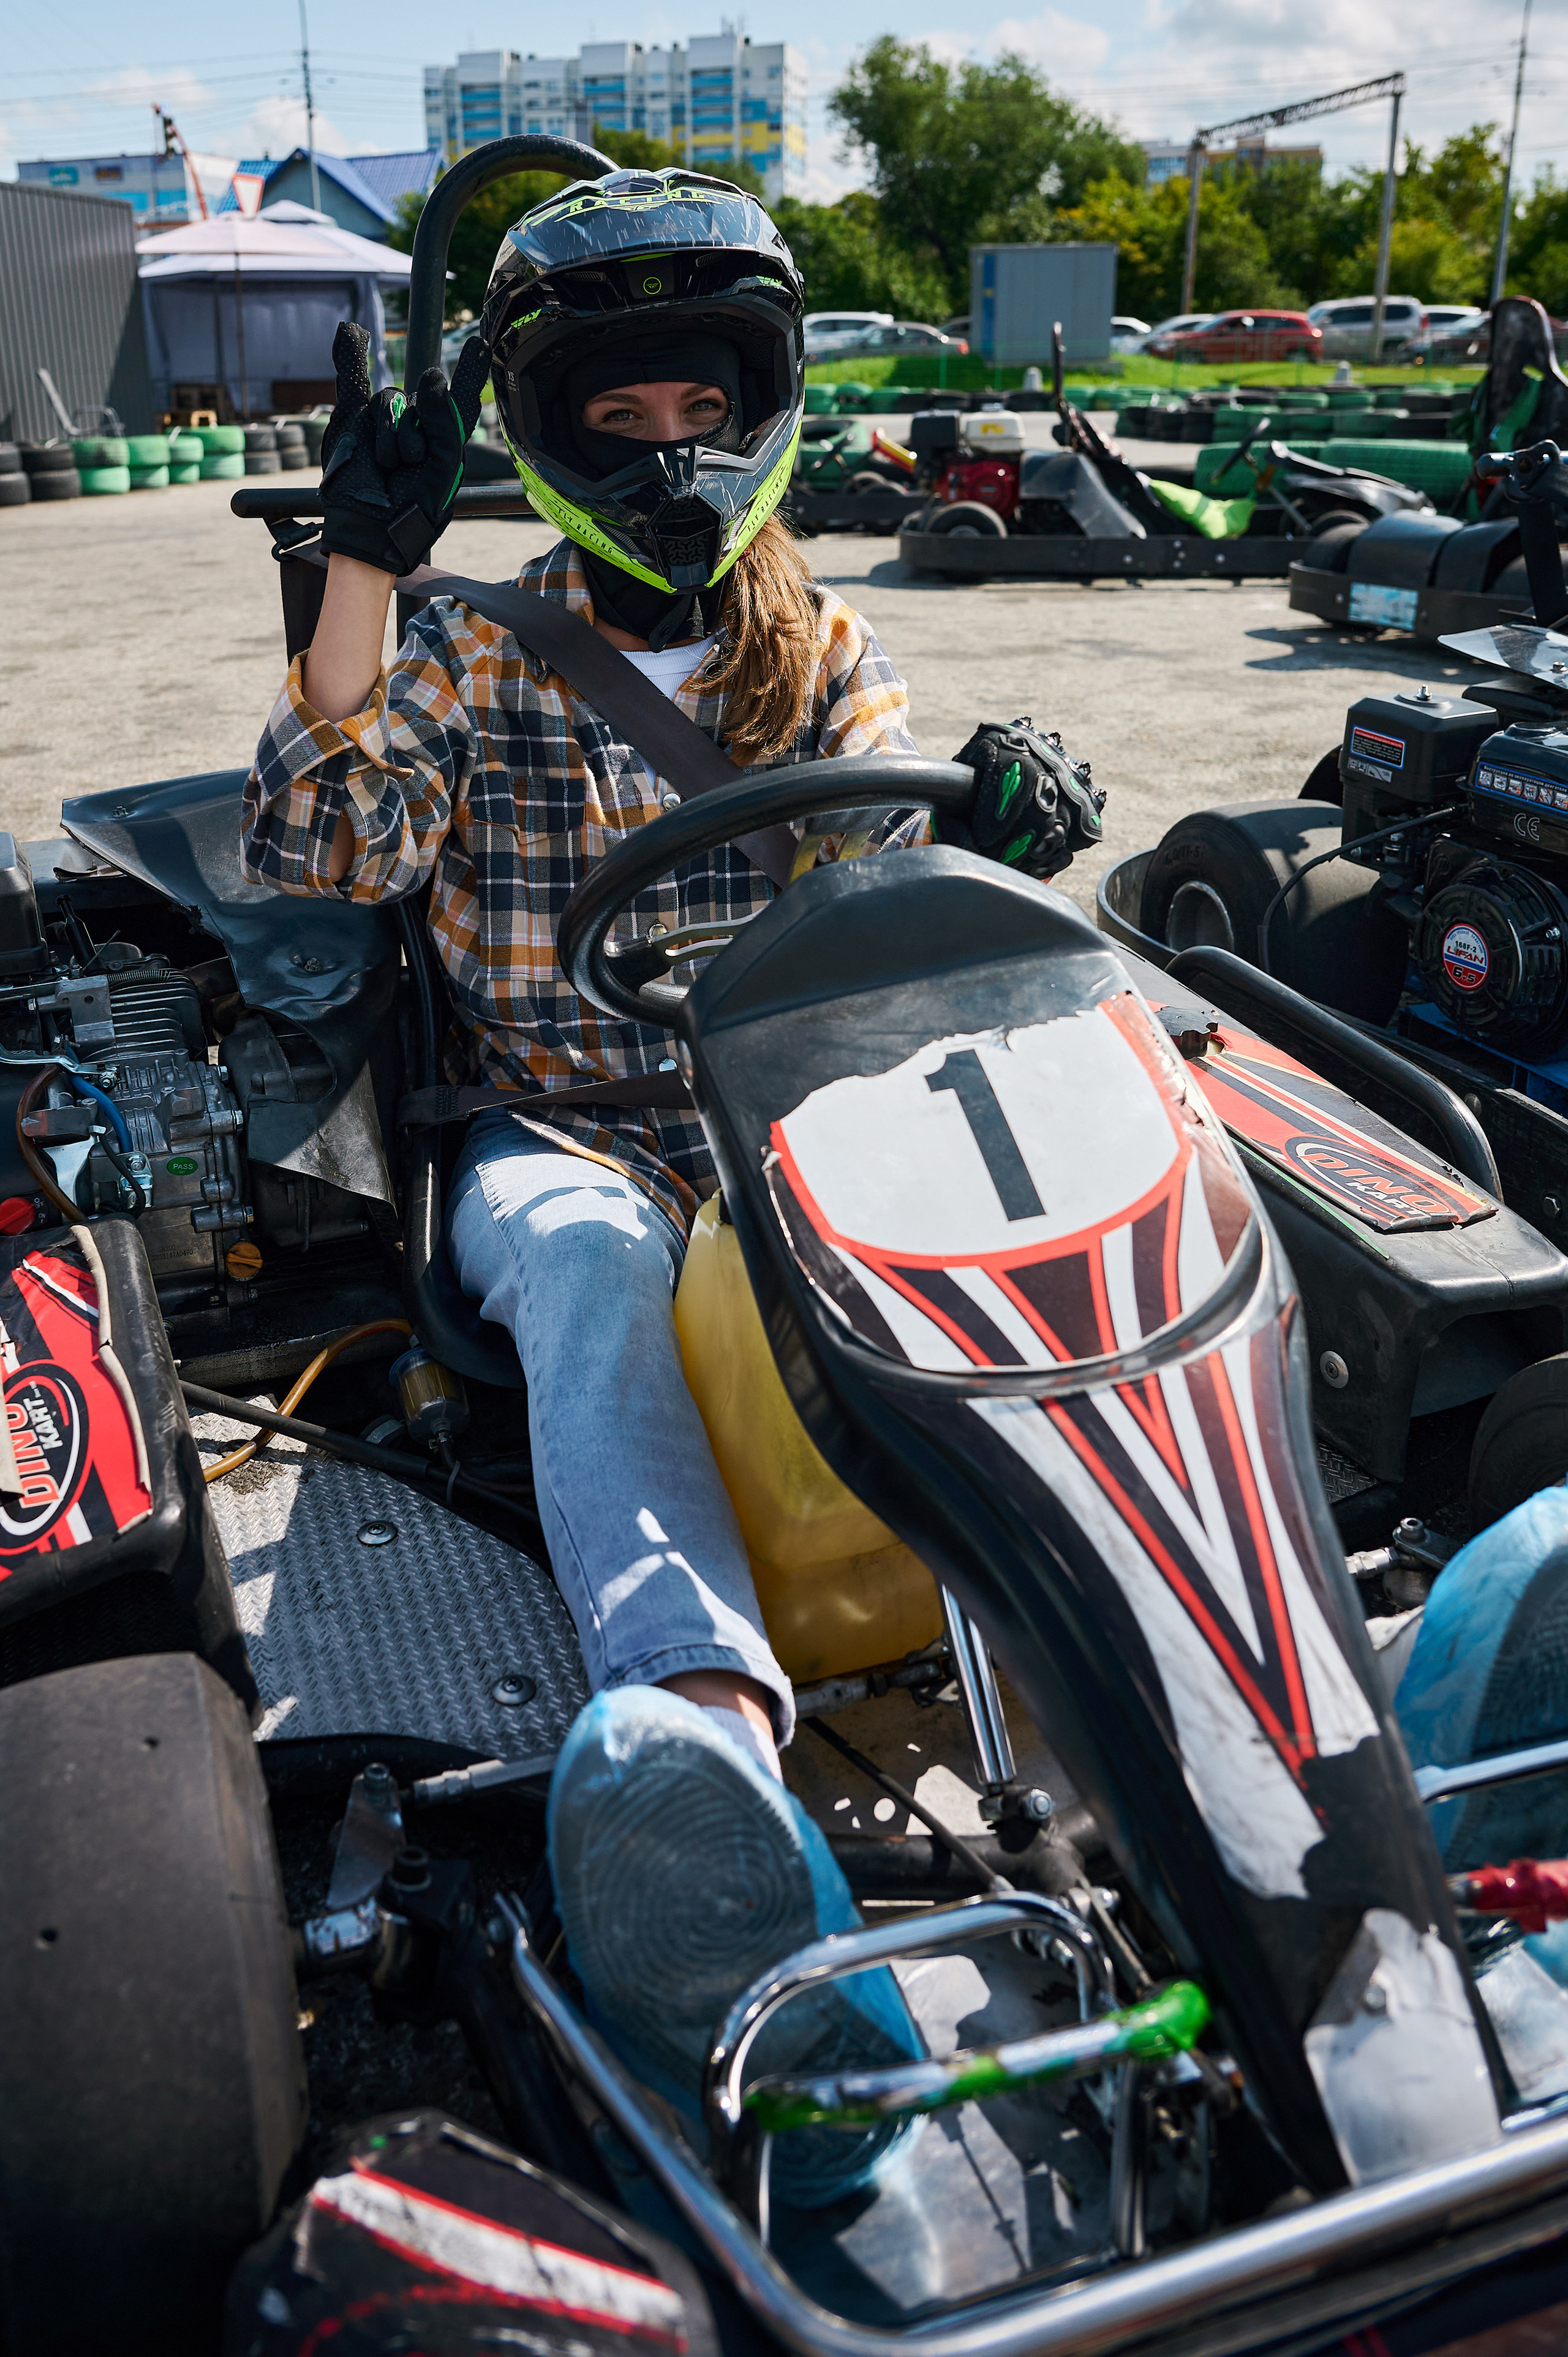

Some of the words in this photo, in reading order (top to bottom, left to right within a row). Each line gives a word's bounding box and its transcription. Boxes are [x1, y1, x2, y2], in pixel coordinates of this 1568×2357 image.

[756, 275, 783, 287] FLY
[511, 308, 542, 328] FLY
[507, 370, 514, 382] YS
[747, 514, 759, 532] FLY
[761, 477, 783, 513] RACING
[558, 508, 573, 523] FLY
[576, 524, 612, 553] RACING
[1514, 813, 1540, 841] CE
[1447, 945, 1484, 964] LIFAN
[1455, 940, 1477, 953] 168F-2
[1452, 966, 1476, 983] 6.5
[924, 1048, 1046, 1222] 1
[1297, 1152, 1450, 1213] DINO
[1345, 1182, 1423, 1218] KART
[23, 1398, 64, 1450] KART
